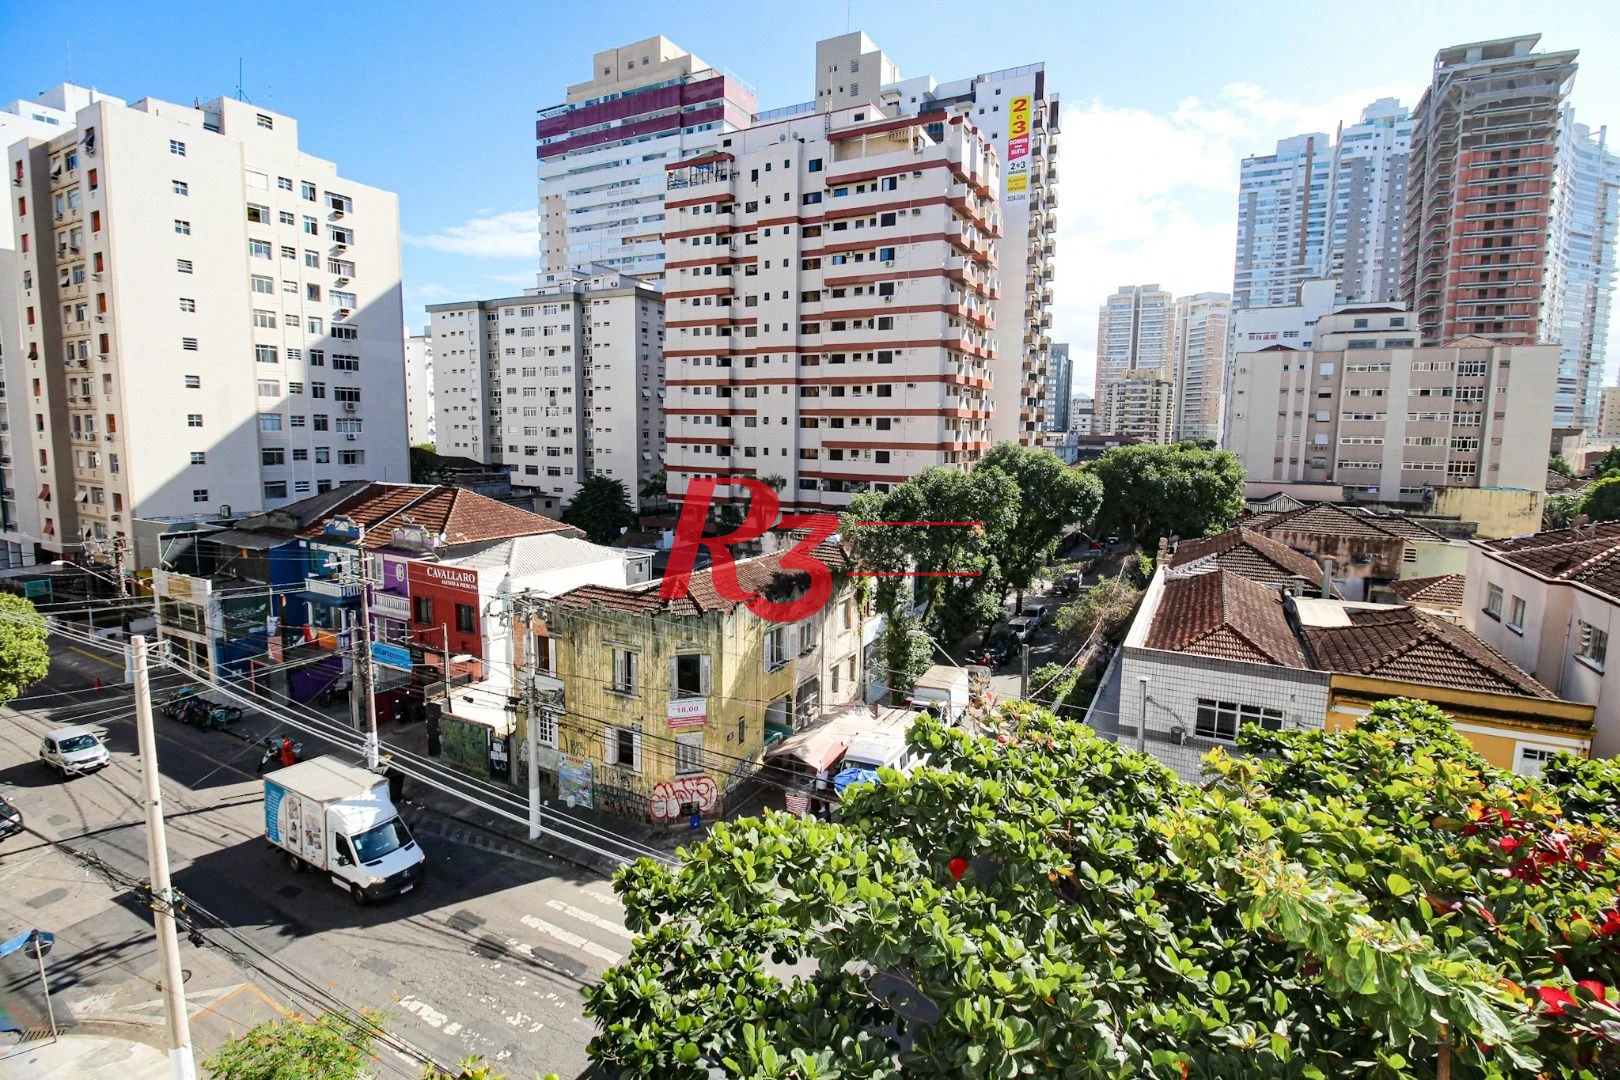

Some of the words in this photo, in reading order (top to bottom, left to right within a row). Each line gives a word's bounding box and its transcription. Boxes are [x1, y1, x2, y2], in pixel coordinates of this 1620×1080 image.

[1013, 99, 1027, 112] 2
[1012, 121, 1026, 133] 3
[1020, 161, 1026, 169] 3
[426, 566, 476, 583] CAVALLARO
